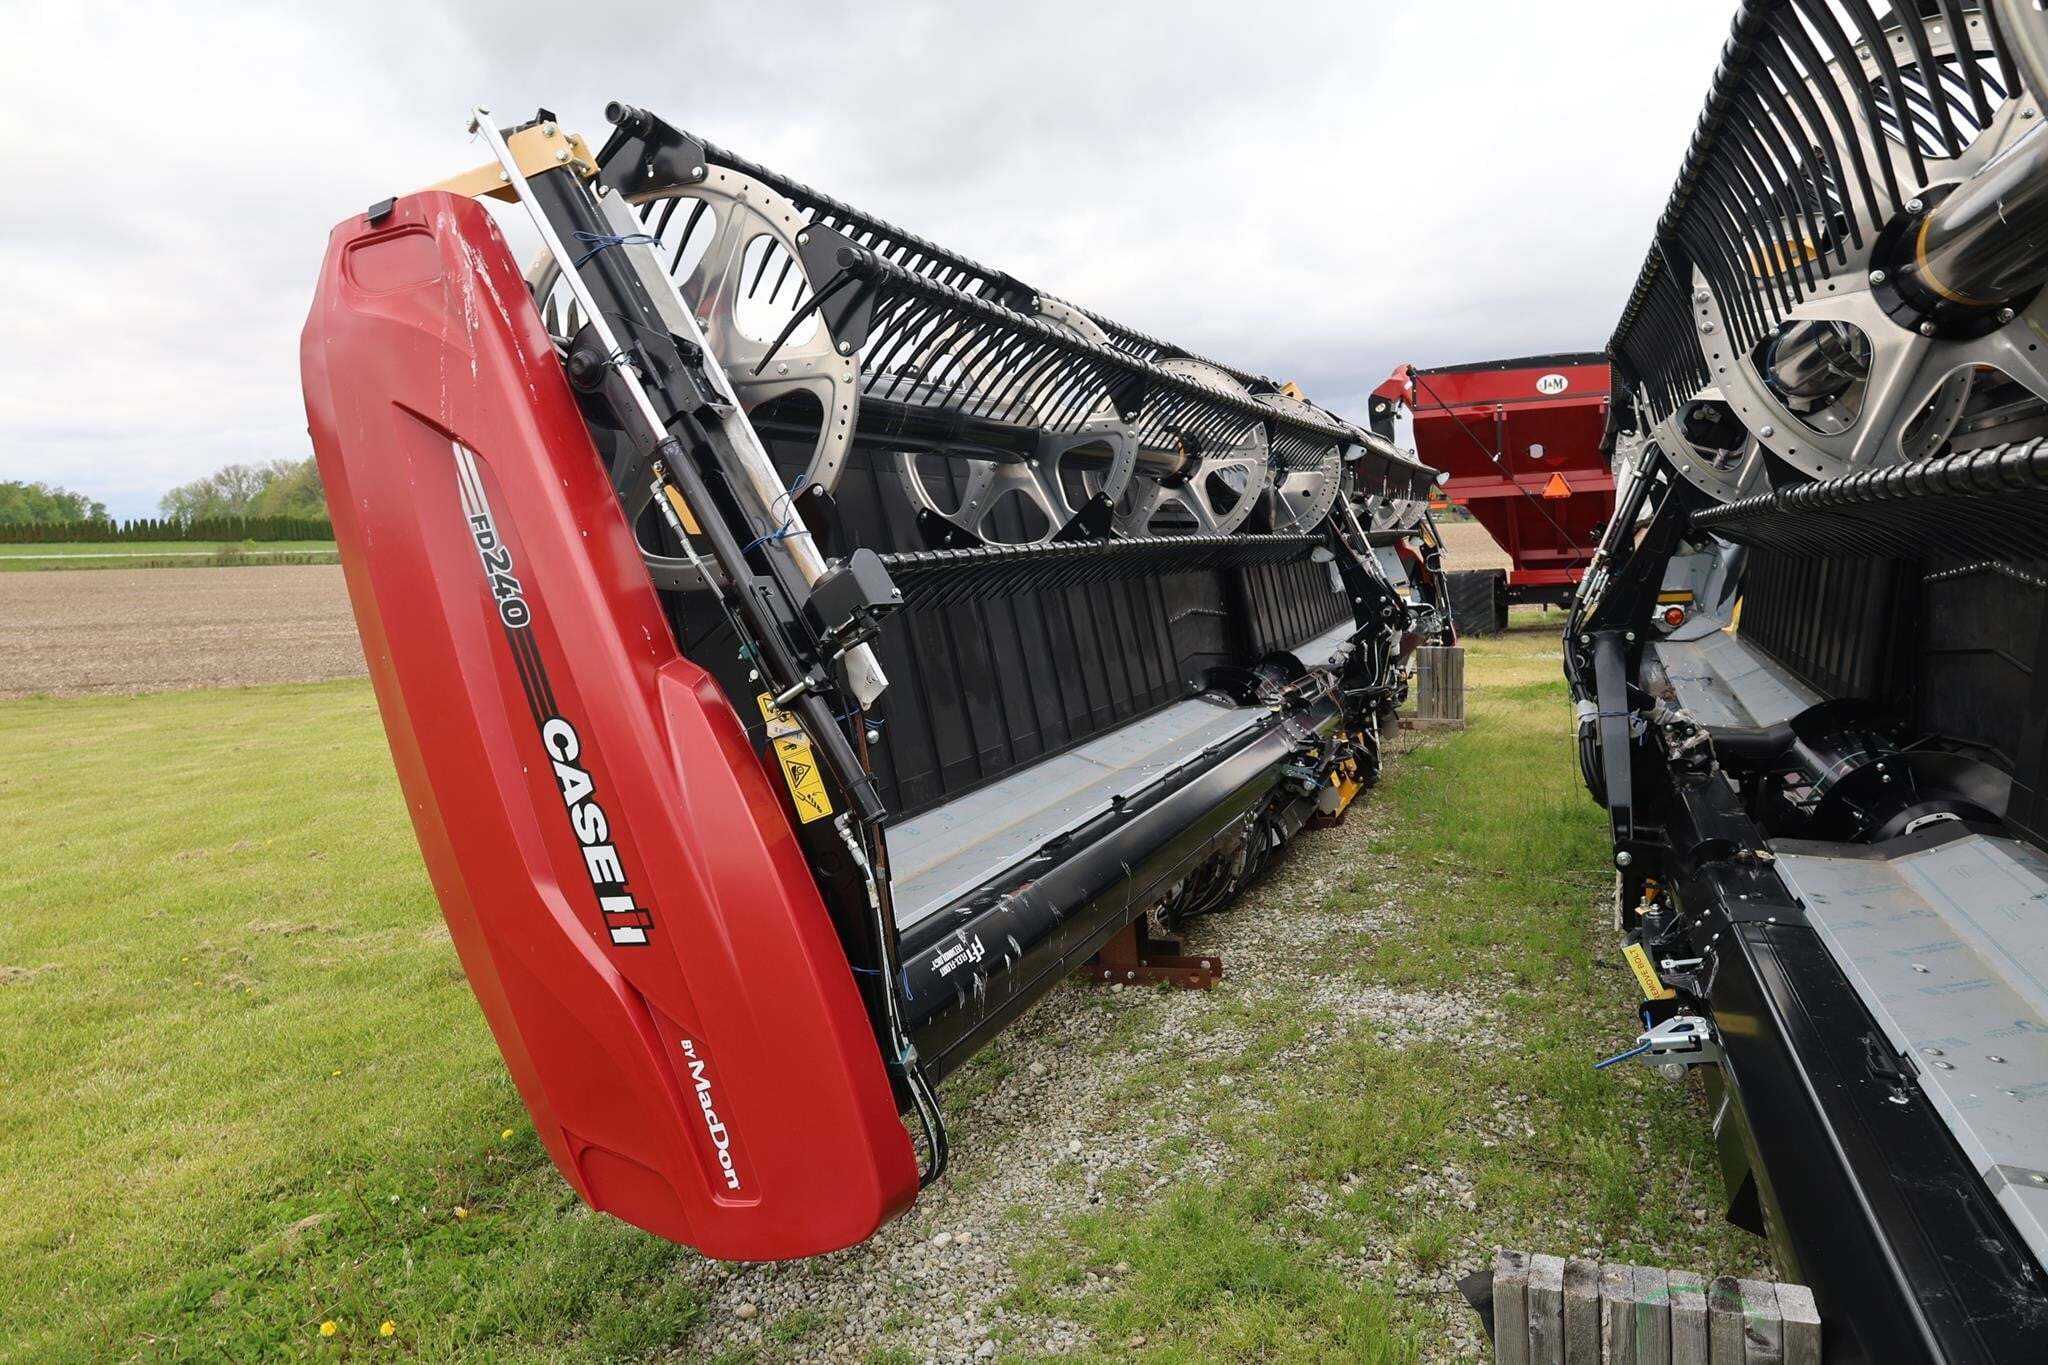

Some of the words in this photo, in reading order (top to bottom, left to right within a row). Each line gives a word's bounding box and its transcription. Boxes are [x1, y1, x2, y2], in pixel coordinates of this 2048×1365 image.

[469, 513, 531, 628] FD240
[543, 718, 627, 884] CASE
[1630, 950, 1645, 969] BOLT
[681, 1040, 696, 1059] BY
[688, 1060, 741, 1190] MacDon
